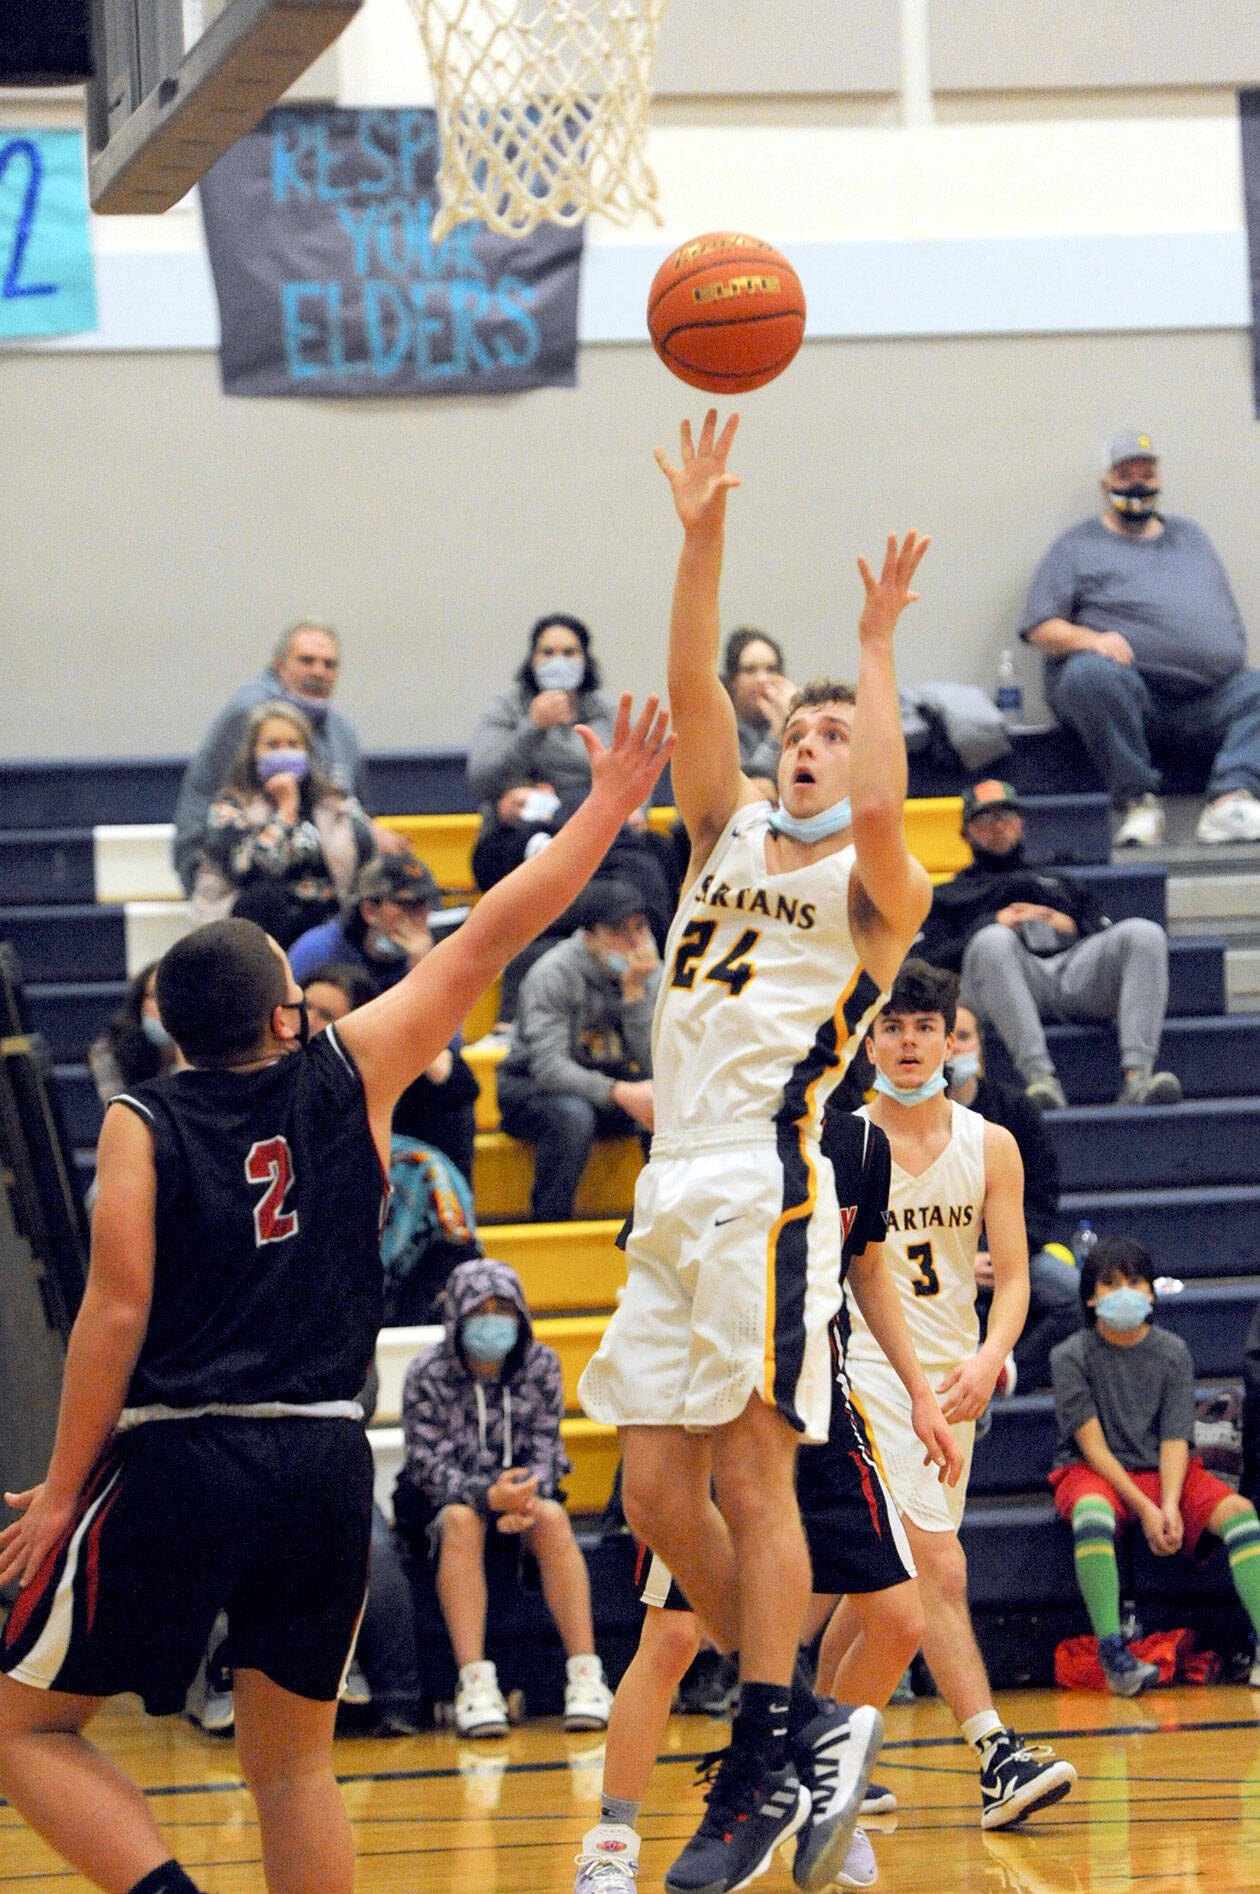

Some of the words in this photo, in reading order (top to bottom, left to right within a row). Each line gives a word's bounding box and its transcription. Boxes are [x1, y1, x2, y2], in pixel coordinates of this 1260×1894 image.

[271, 110, 480, 203] RESP
[0, 138, 57, 298] 2
[338, 198, 484, 277] YOUR
[281, 276, 542, 379] ELDERS
[668, 916, 762, 999] 24
[244, 1134, 299, 1248] 2
[885, 1205, 974, 1233] ARTANS
[906, 1239, 941, 1298] 3
